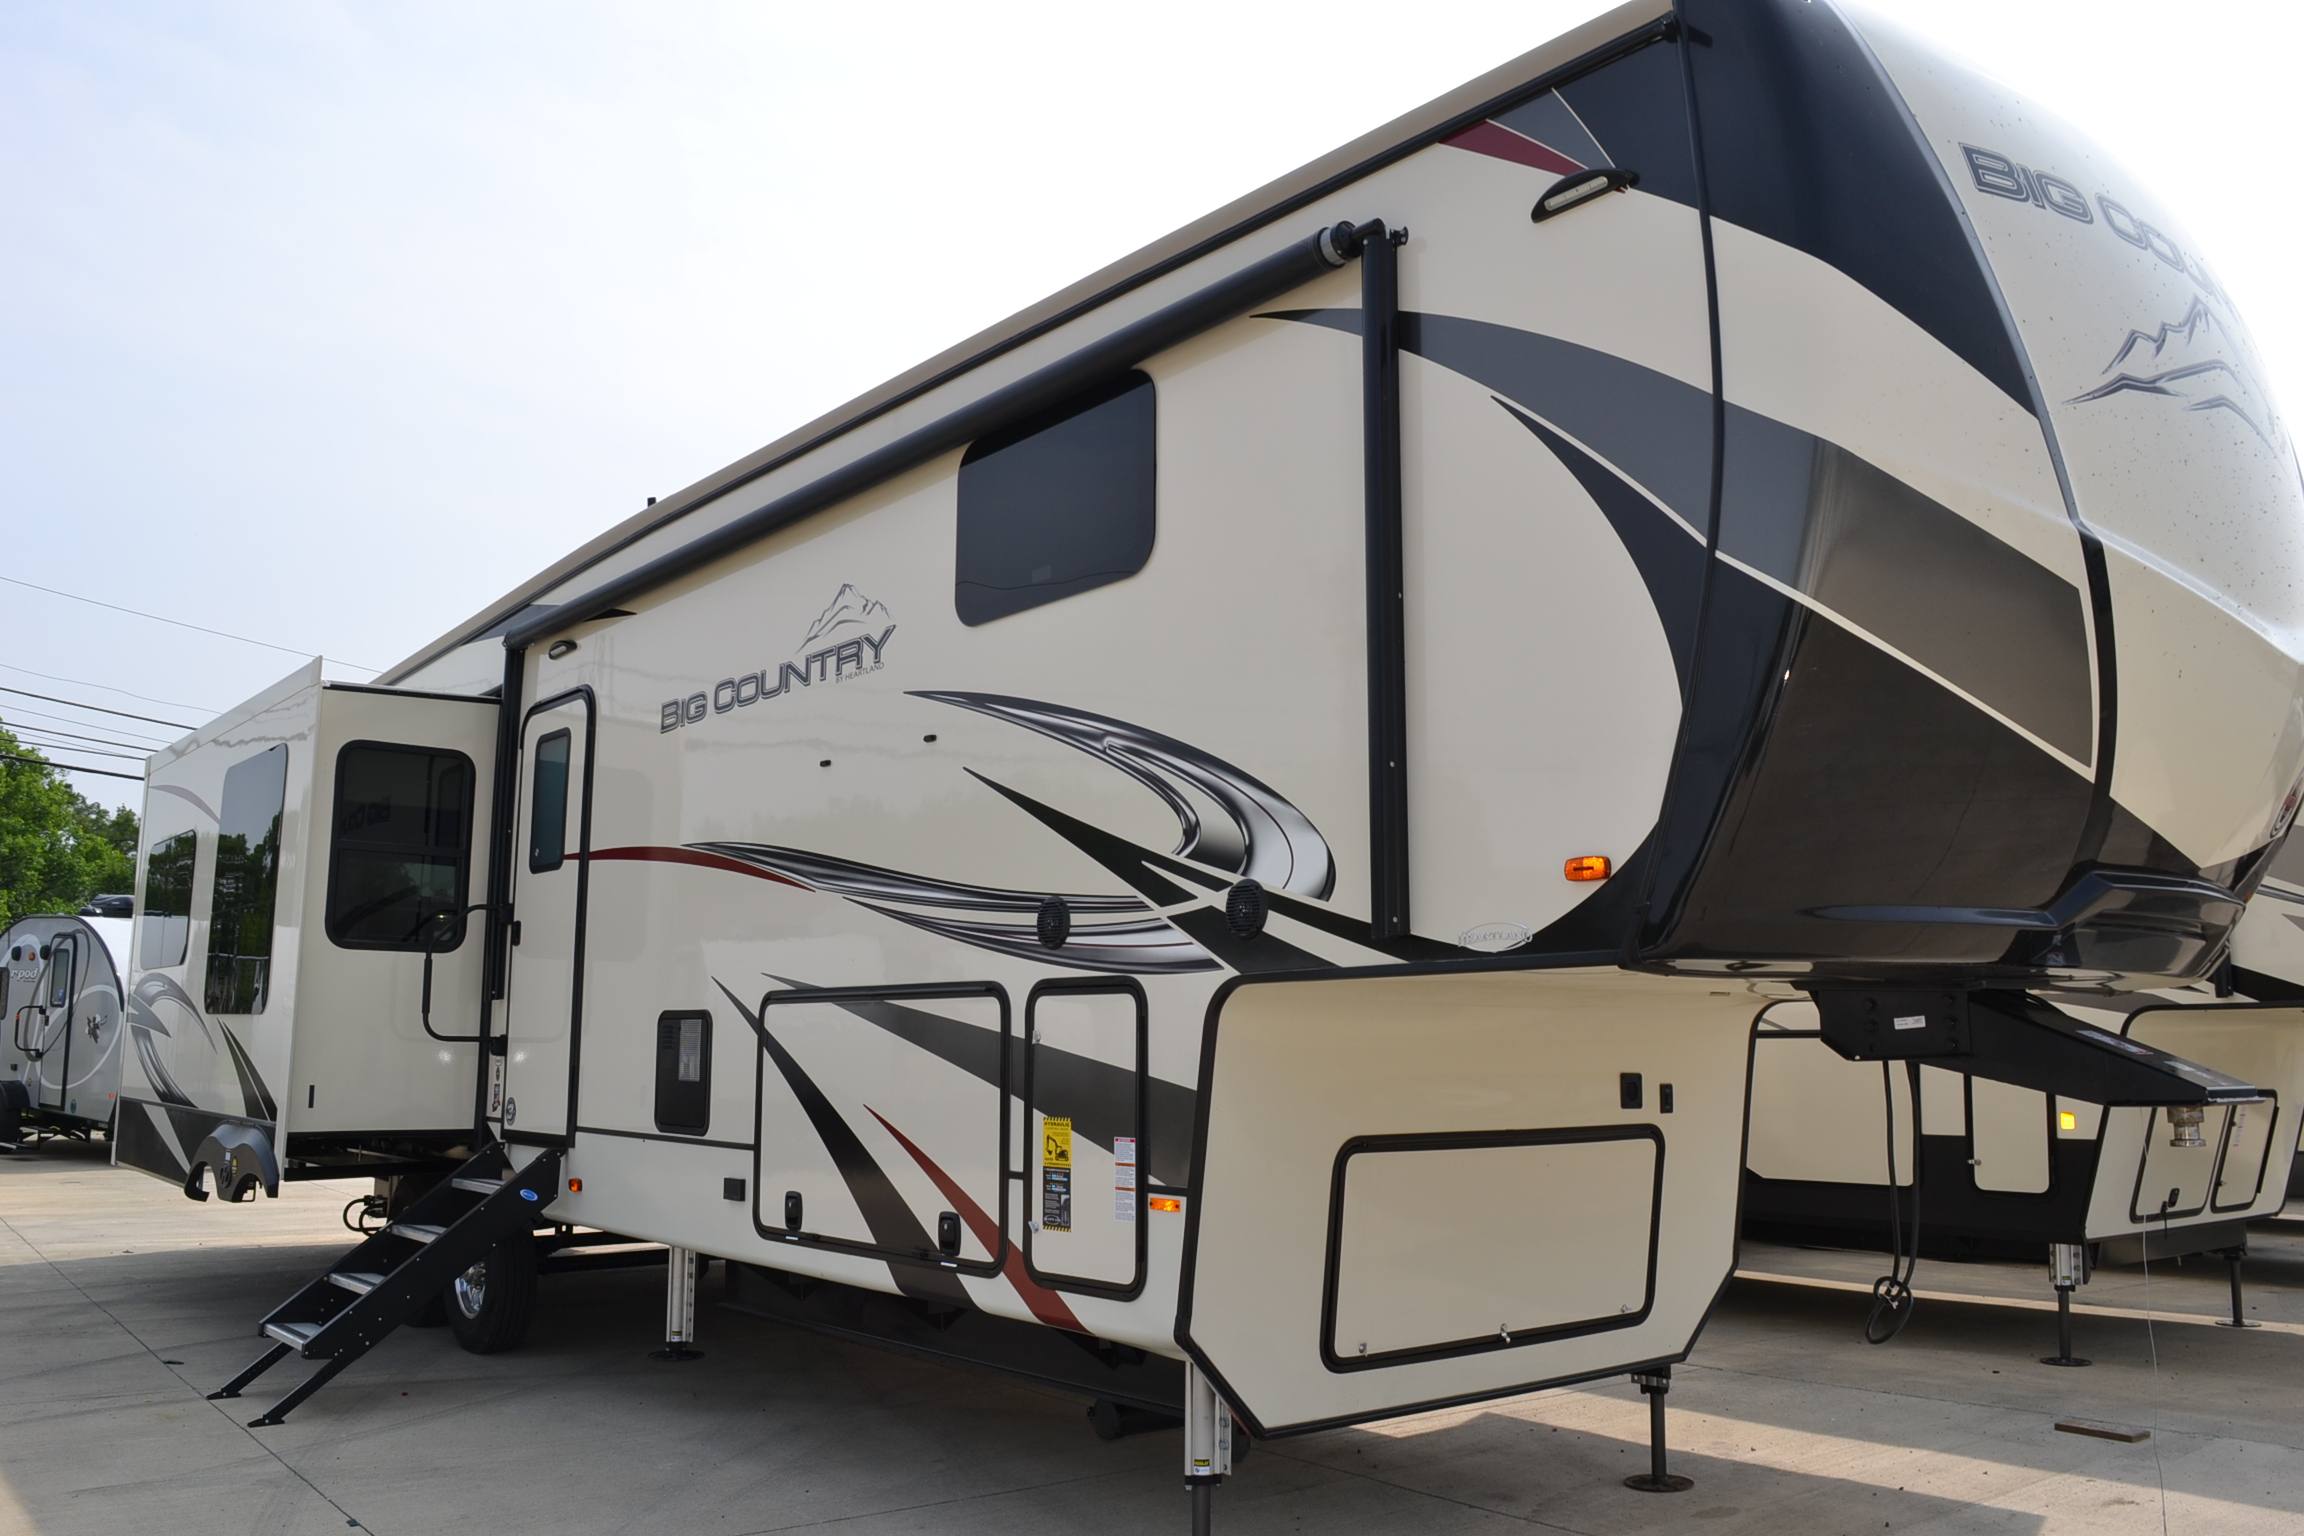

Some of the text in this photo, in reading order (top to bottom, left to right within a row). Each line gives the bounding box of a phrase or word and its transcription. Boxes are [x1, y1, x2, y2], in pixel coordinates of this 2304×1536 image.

[1957, 141, 2095, 226] BIG
[659, 623, 898, 735] BIG COUNTRY
[835, 661, 885, 684] BY HEARTLAND
